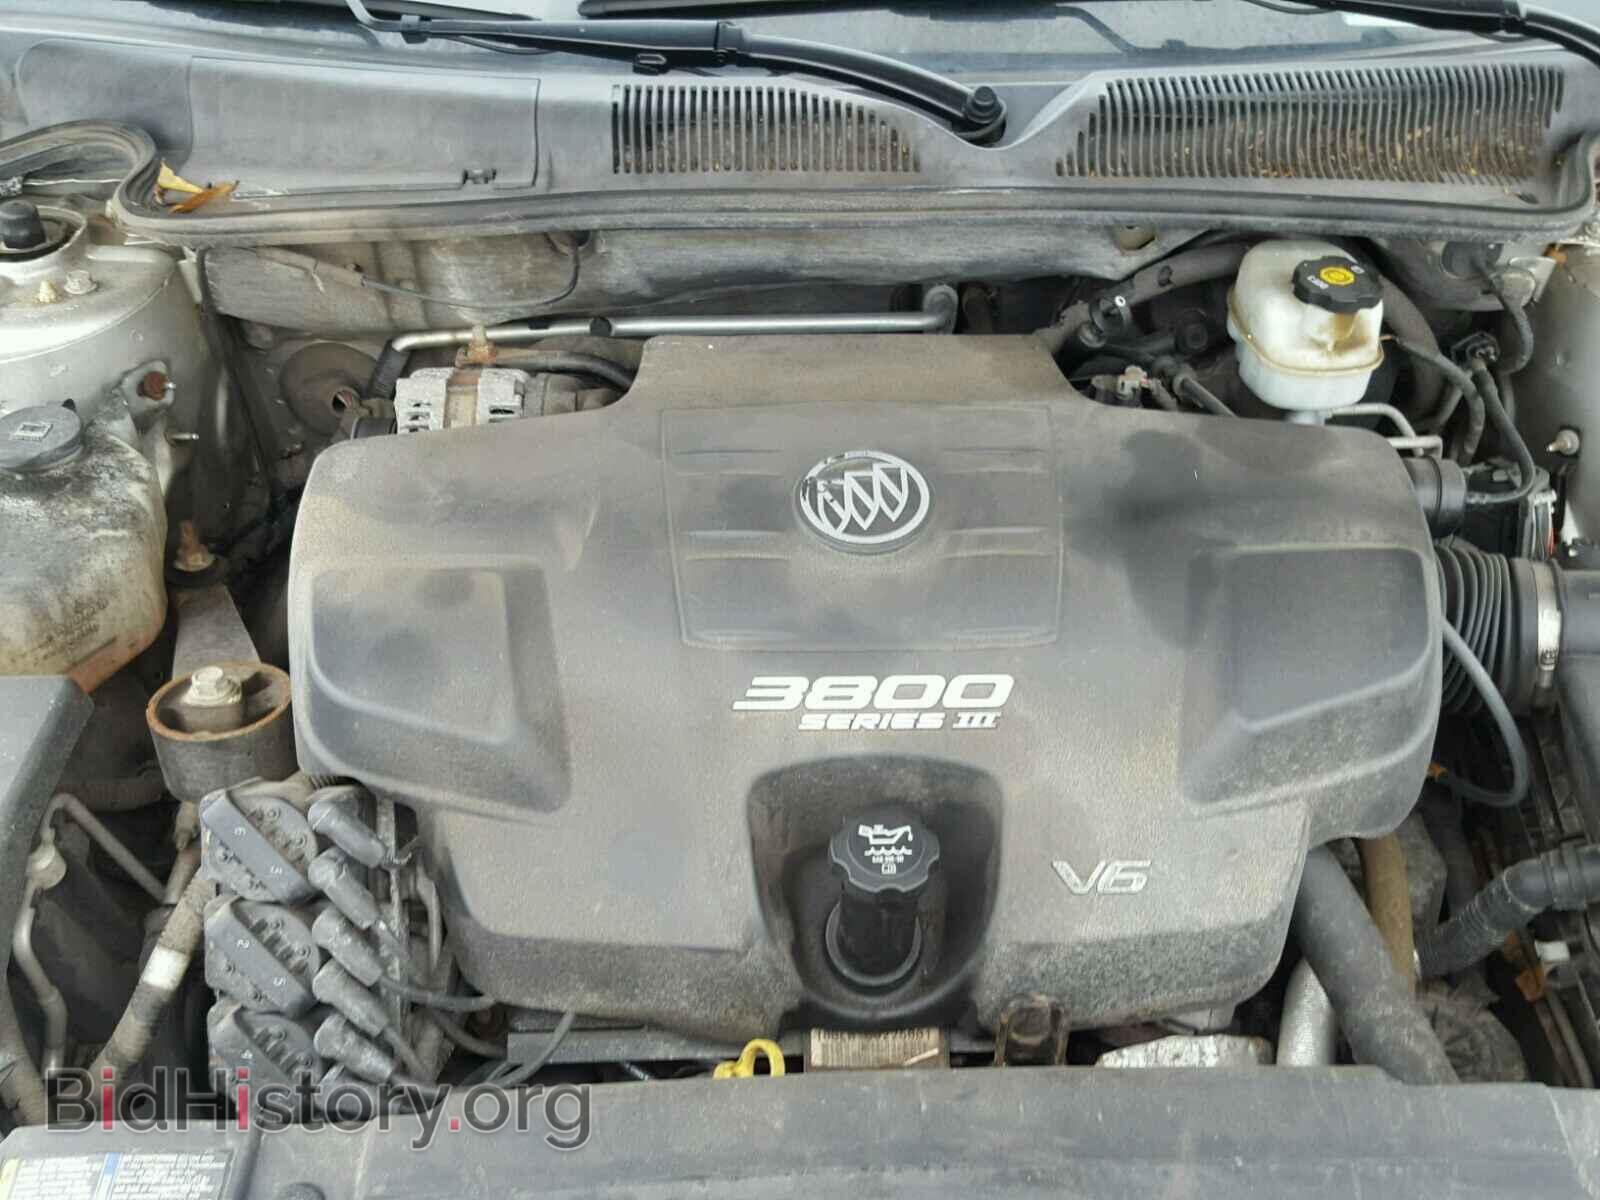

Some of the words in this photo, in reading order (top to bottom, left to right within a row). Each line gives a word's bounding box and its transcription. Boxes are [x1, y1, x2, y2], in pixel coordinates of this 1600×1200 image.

[732, 674, 1014, 711] 3800
[798, 712, 945, 731] SERIES
[952, 711, 1002, 730] III
[1051, 860, 1152, 895] V6
